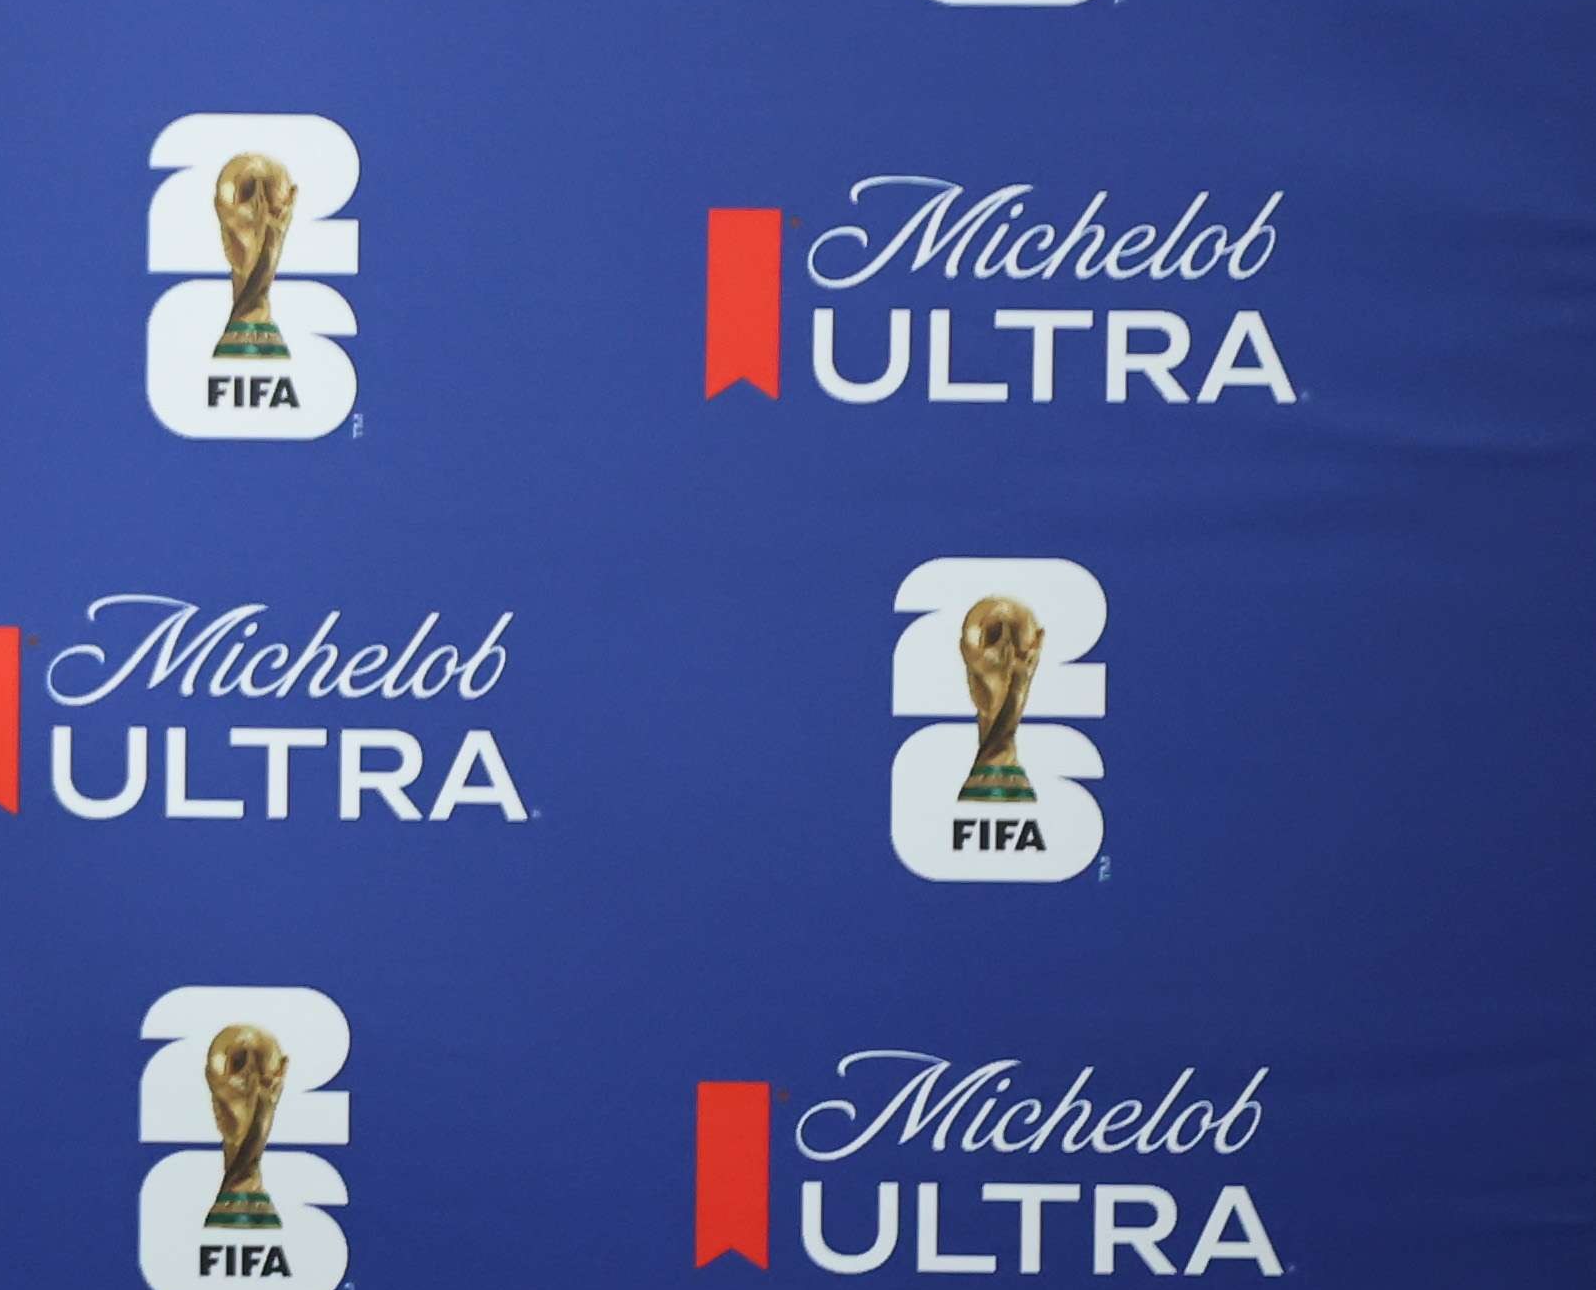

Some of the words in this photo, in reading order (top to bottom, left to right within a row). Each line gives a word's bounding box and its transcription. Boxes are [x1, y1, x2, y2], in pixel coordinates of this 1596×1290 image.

[808, 176, 1283, 288] Michelob
[208, 377, 299, 407] FIFA
[812, 308, 1297, 404] ULTRA
[47, 594, 513, 706] Michelob
[51, 725, 528, 821] ULTRA
[953, 820, 1045, 851] FIFA
[796, 1050, 1269, 1161] Michelob
[200, 1246, 290, 1277] FIFA
[801, 1181, 1284, 1276] ULTRA
